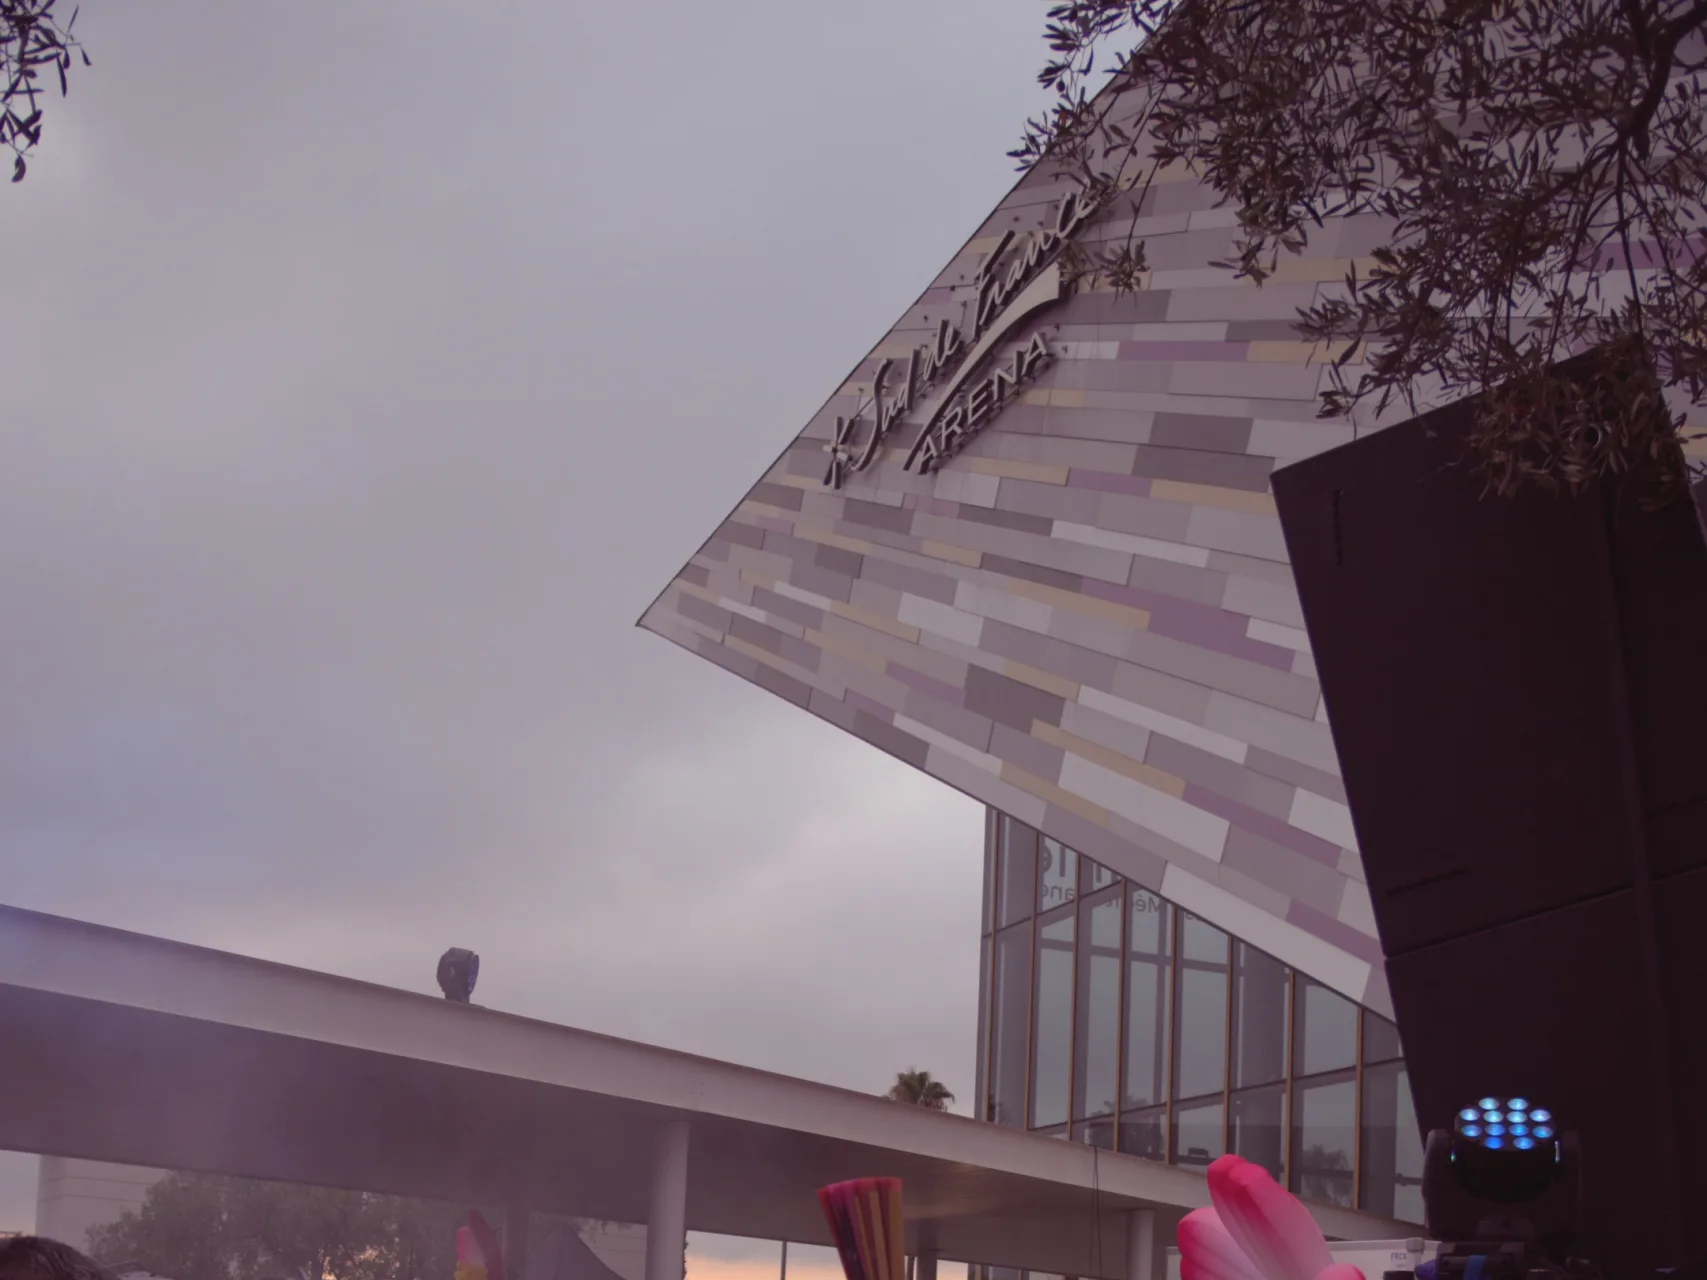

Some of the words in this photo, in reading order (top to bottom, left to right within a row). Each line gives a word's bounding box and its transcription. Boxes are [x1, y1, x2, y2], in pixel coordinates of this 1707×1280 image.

[850, 349, 921, 472] Sud
[922, 319, 965, 382] de
[972, 188, 1100, 342] France
[917, 331, 1055, 475] ARENA
